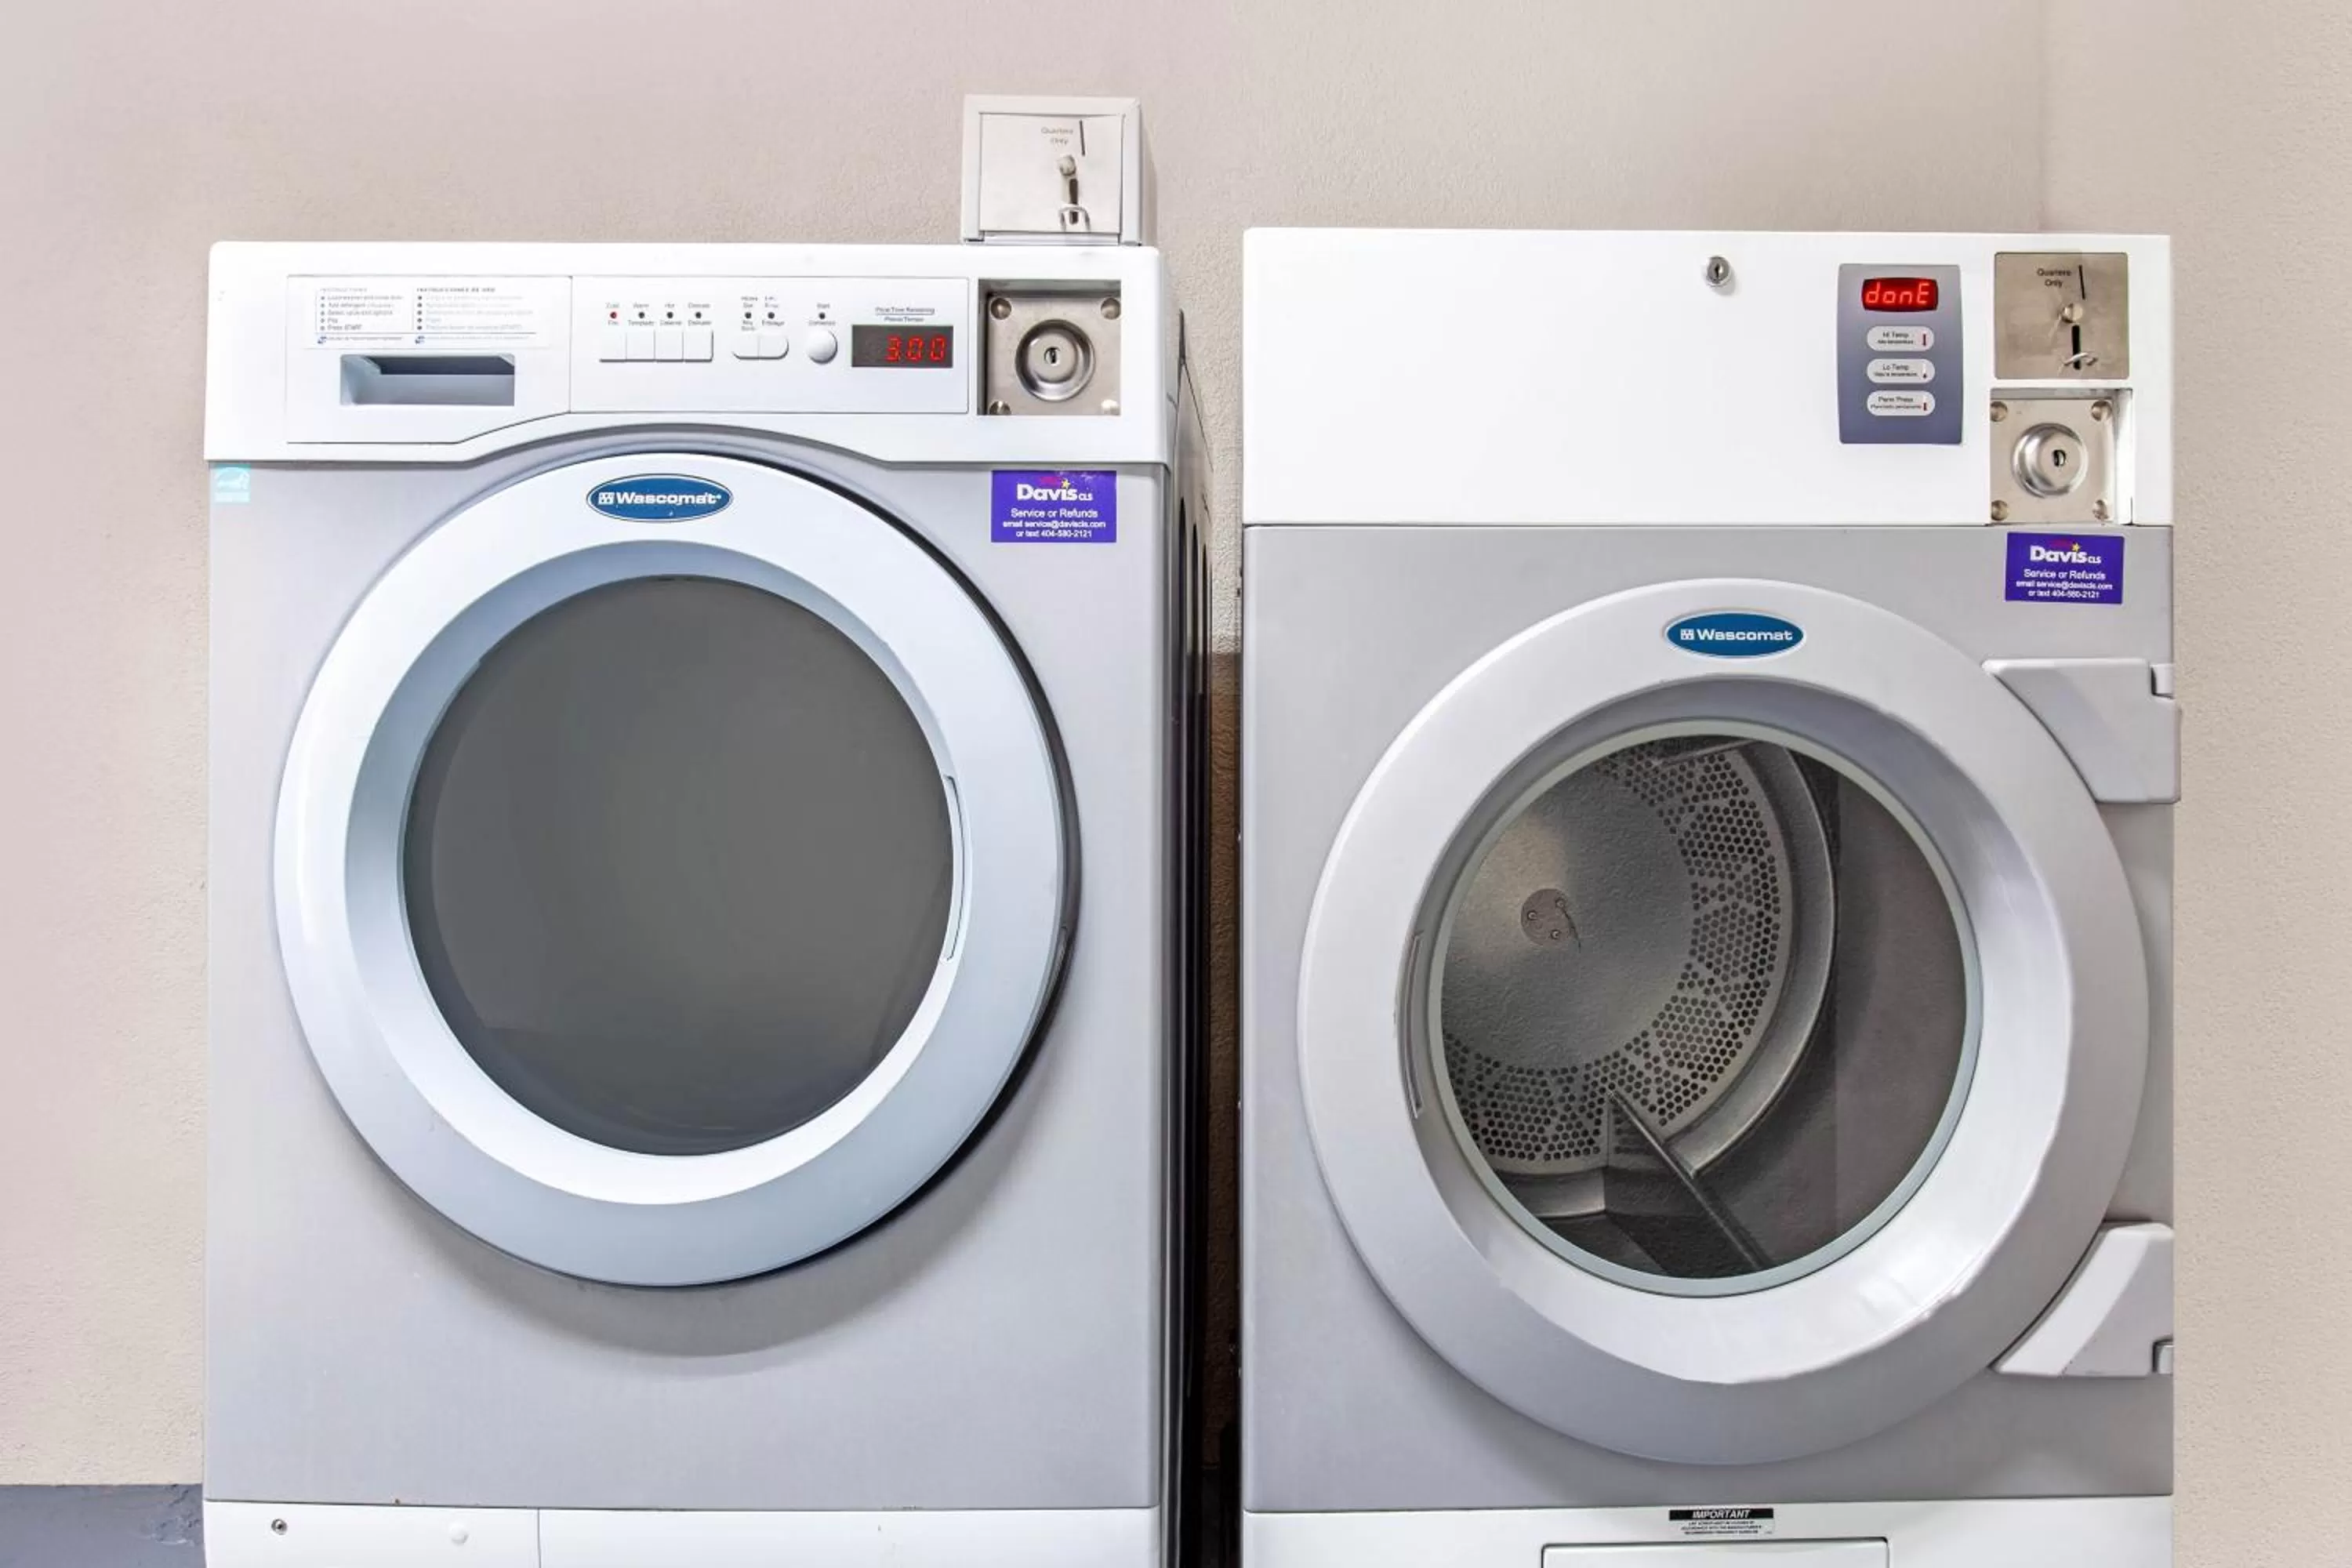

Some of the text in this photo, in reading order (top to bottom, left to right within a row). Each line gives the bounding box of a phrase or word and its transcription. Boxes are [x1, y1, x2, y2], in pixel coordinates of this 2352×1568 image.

[2037, 267, 2071, 277] Quarters
[2045, 278, 2063, 289] Only
[1017, 482, 1078, 501] Davis
[1011, 508, 1098, 518] Service or Refunds
[2030, 544, 2087, 563] Davis
[2024, 568, 2056, 578] Service
[2069, 570, 2106, 580] Refunds
[1696, 628, 1793, 641] Wascomat
[1692, 1509, 1751, 1519] IMPORTANT
